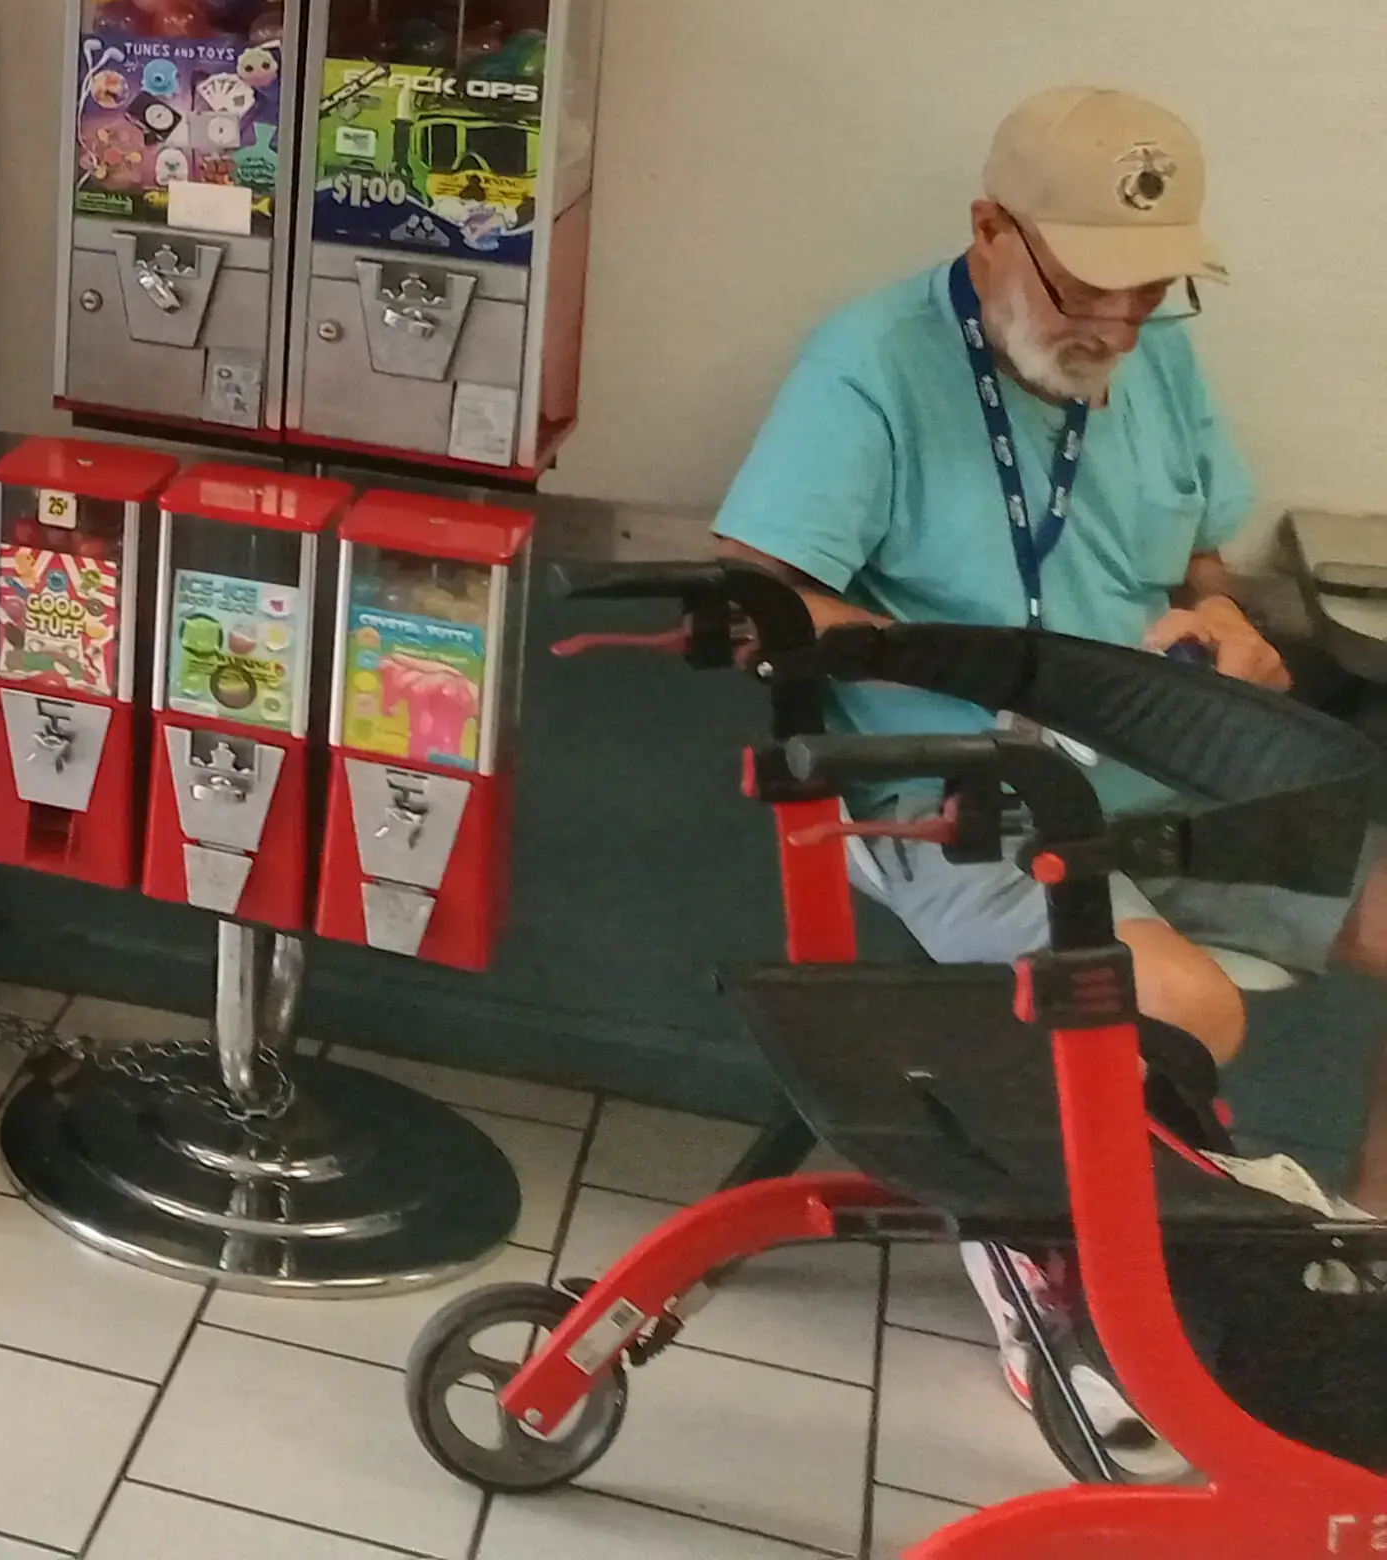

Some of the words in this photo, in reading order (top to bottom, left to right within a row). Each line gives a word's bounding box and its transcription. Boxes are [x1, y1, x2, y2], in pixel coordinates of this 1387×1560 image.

[124, 42, 171, 58] TUNES
[174, 47, 195, 59] AND
[197, 45, 236, 61] TOYS
[465, 79, 540, 103] OPS
[331, 171, 407, 209] $1.00
[26, 592, 86, 620] GOOD
[24, 614, 87, 640] STUFF
